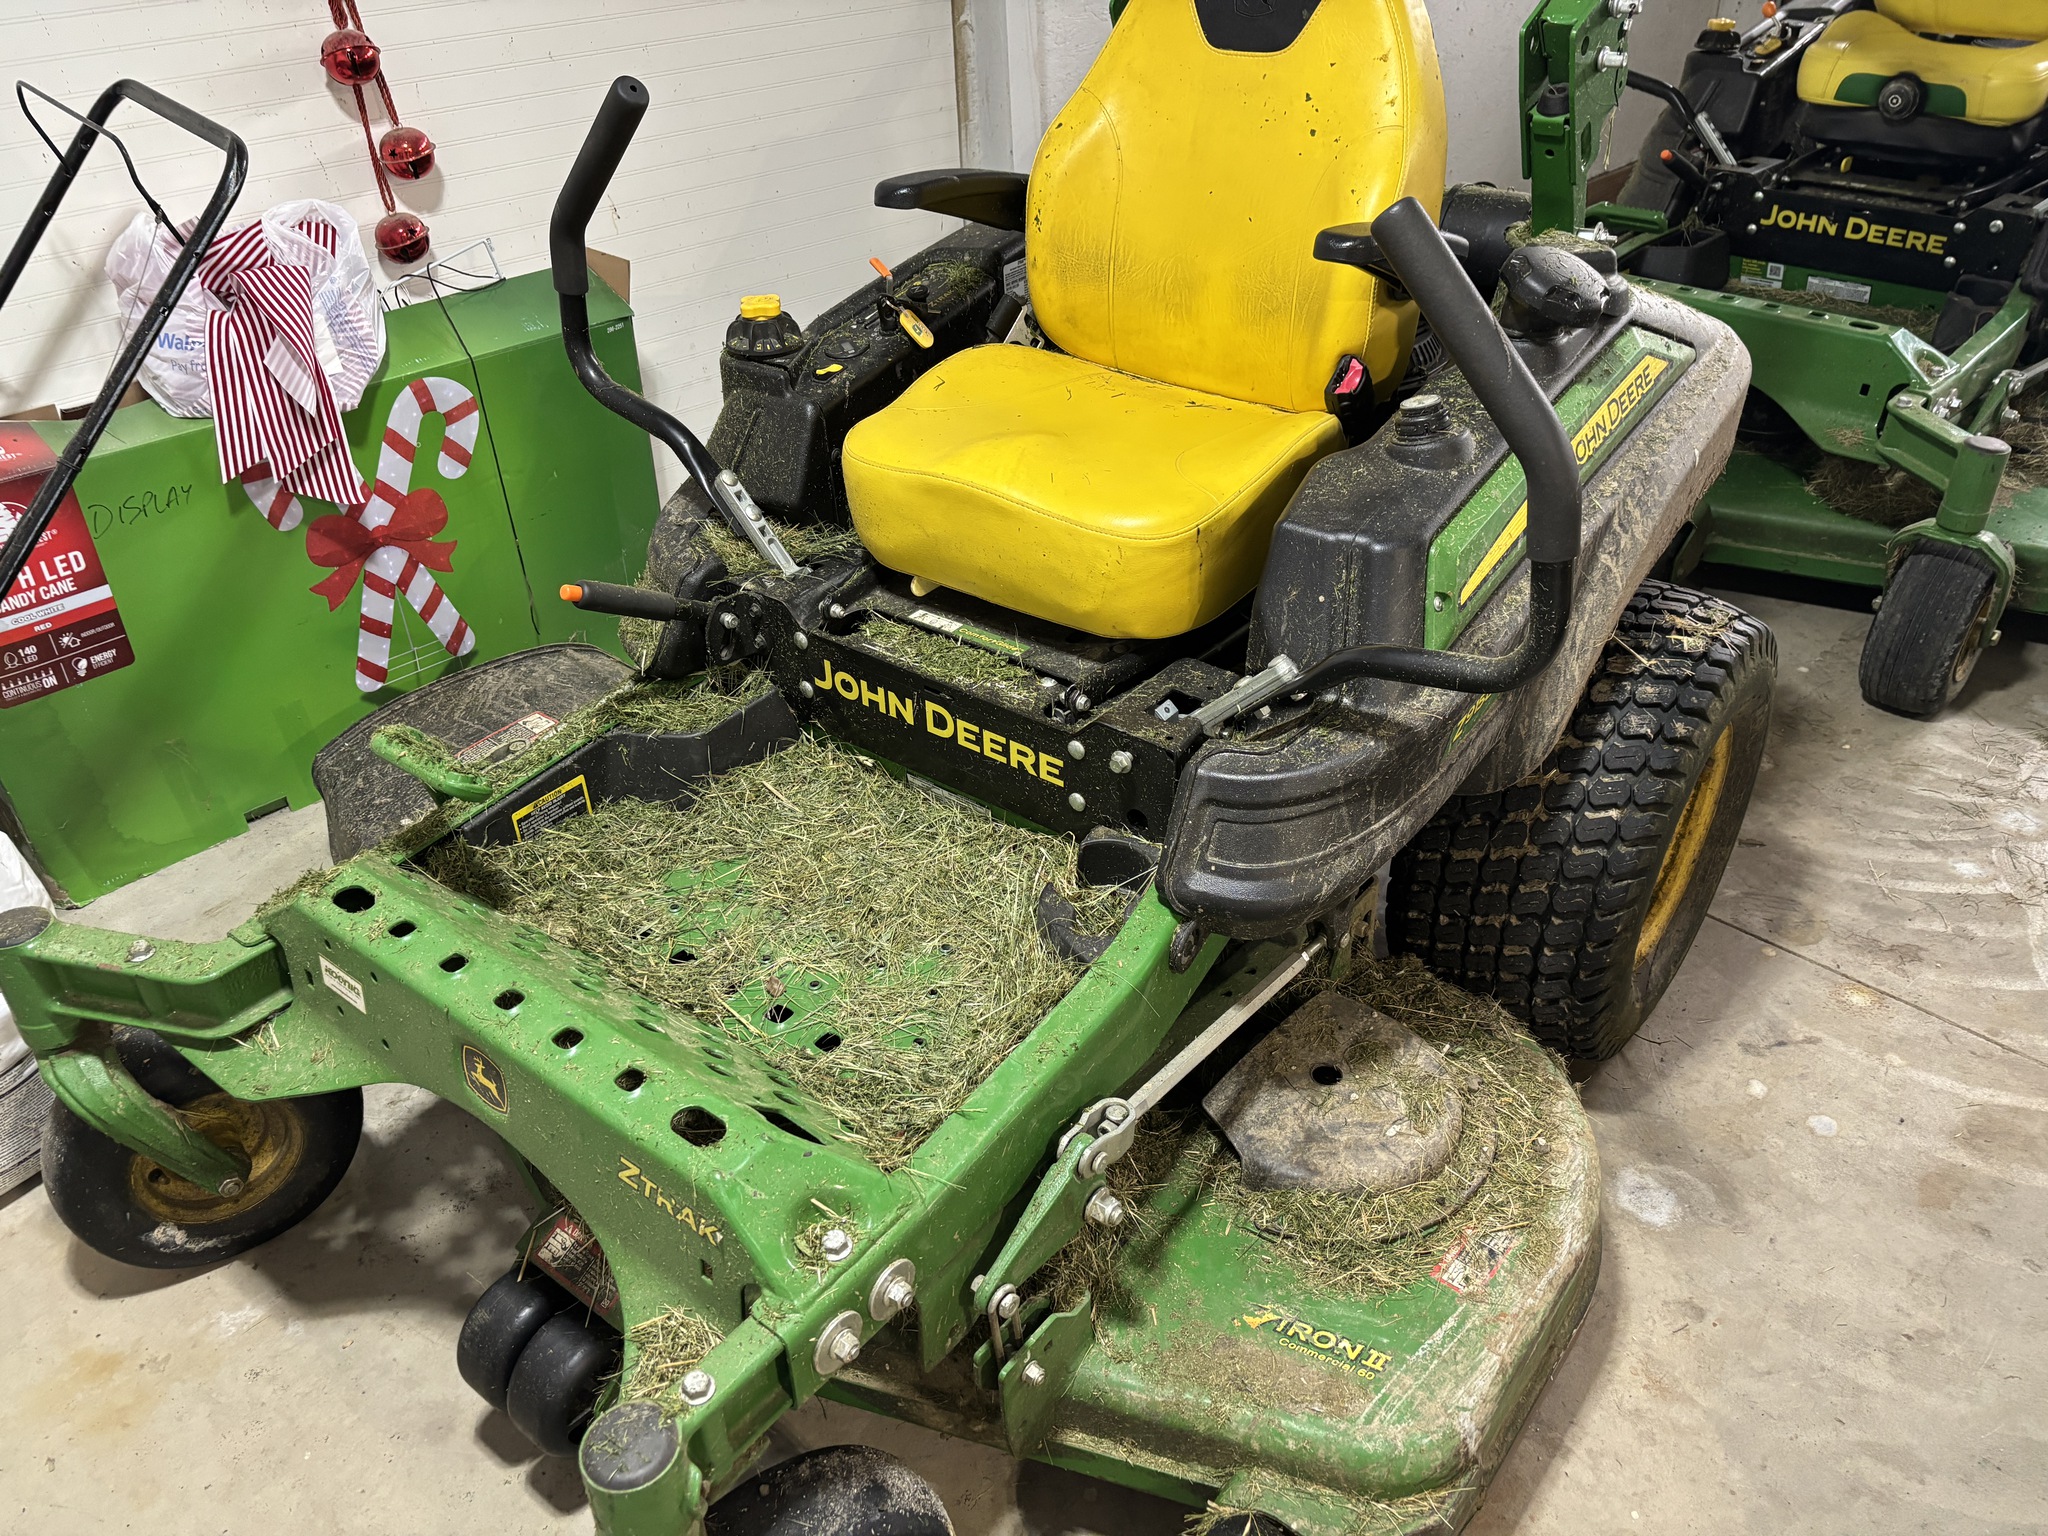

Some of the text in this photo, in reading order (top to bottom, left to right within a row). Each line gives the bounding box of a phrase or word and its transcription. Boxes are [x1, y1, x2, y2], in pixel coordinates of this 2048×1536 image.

[1760, 204, 1948, 255] JOHN DEERE
[1575, 363, 1654, 462] OHN DEERE
[87, 484, 193, 540] DISPLAY
[39, 550, 87, 582] LED
[0, 577, 78, 614] ANDY CANE
[11, 603, 66, 626] COOL WHITE
[33, 621, 53, 632] RED
[18, 644, 38, 658] 140
[22, 654, 39, 665] LED
[89, 648, 117, 665] ENERGY
[2, 680, 43, 700] CONTINUOUS
[42, 674, 59, 689] ON
[814, 659, 1065, 788] JOHN DEERE
[540, 789, 563, 808] CAUTION
[618, 1155, 720, 1247] ZTRAK
[1279, 1337, 1376, 1381] Commercial 60
